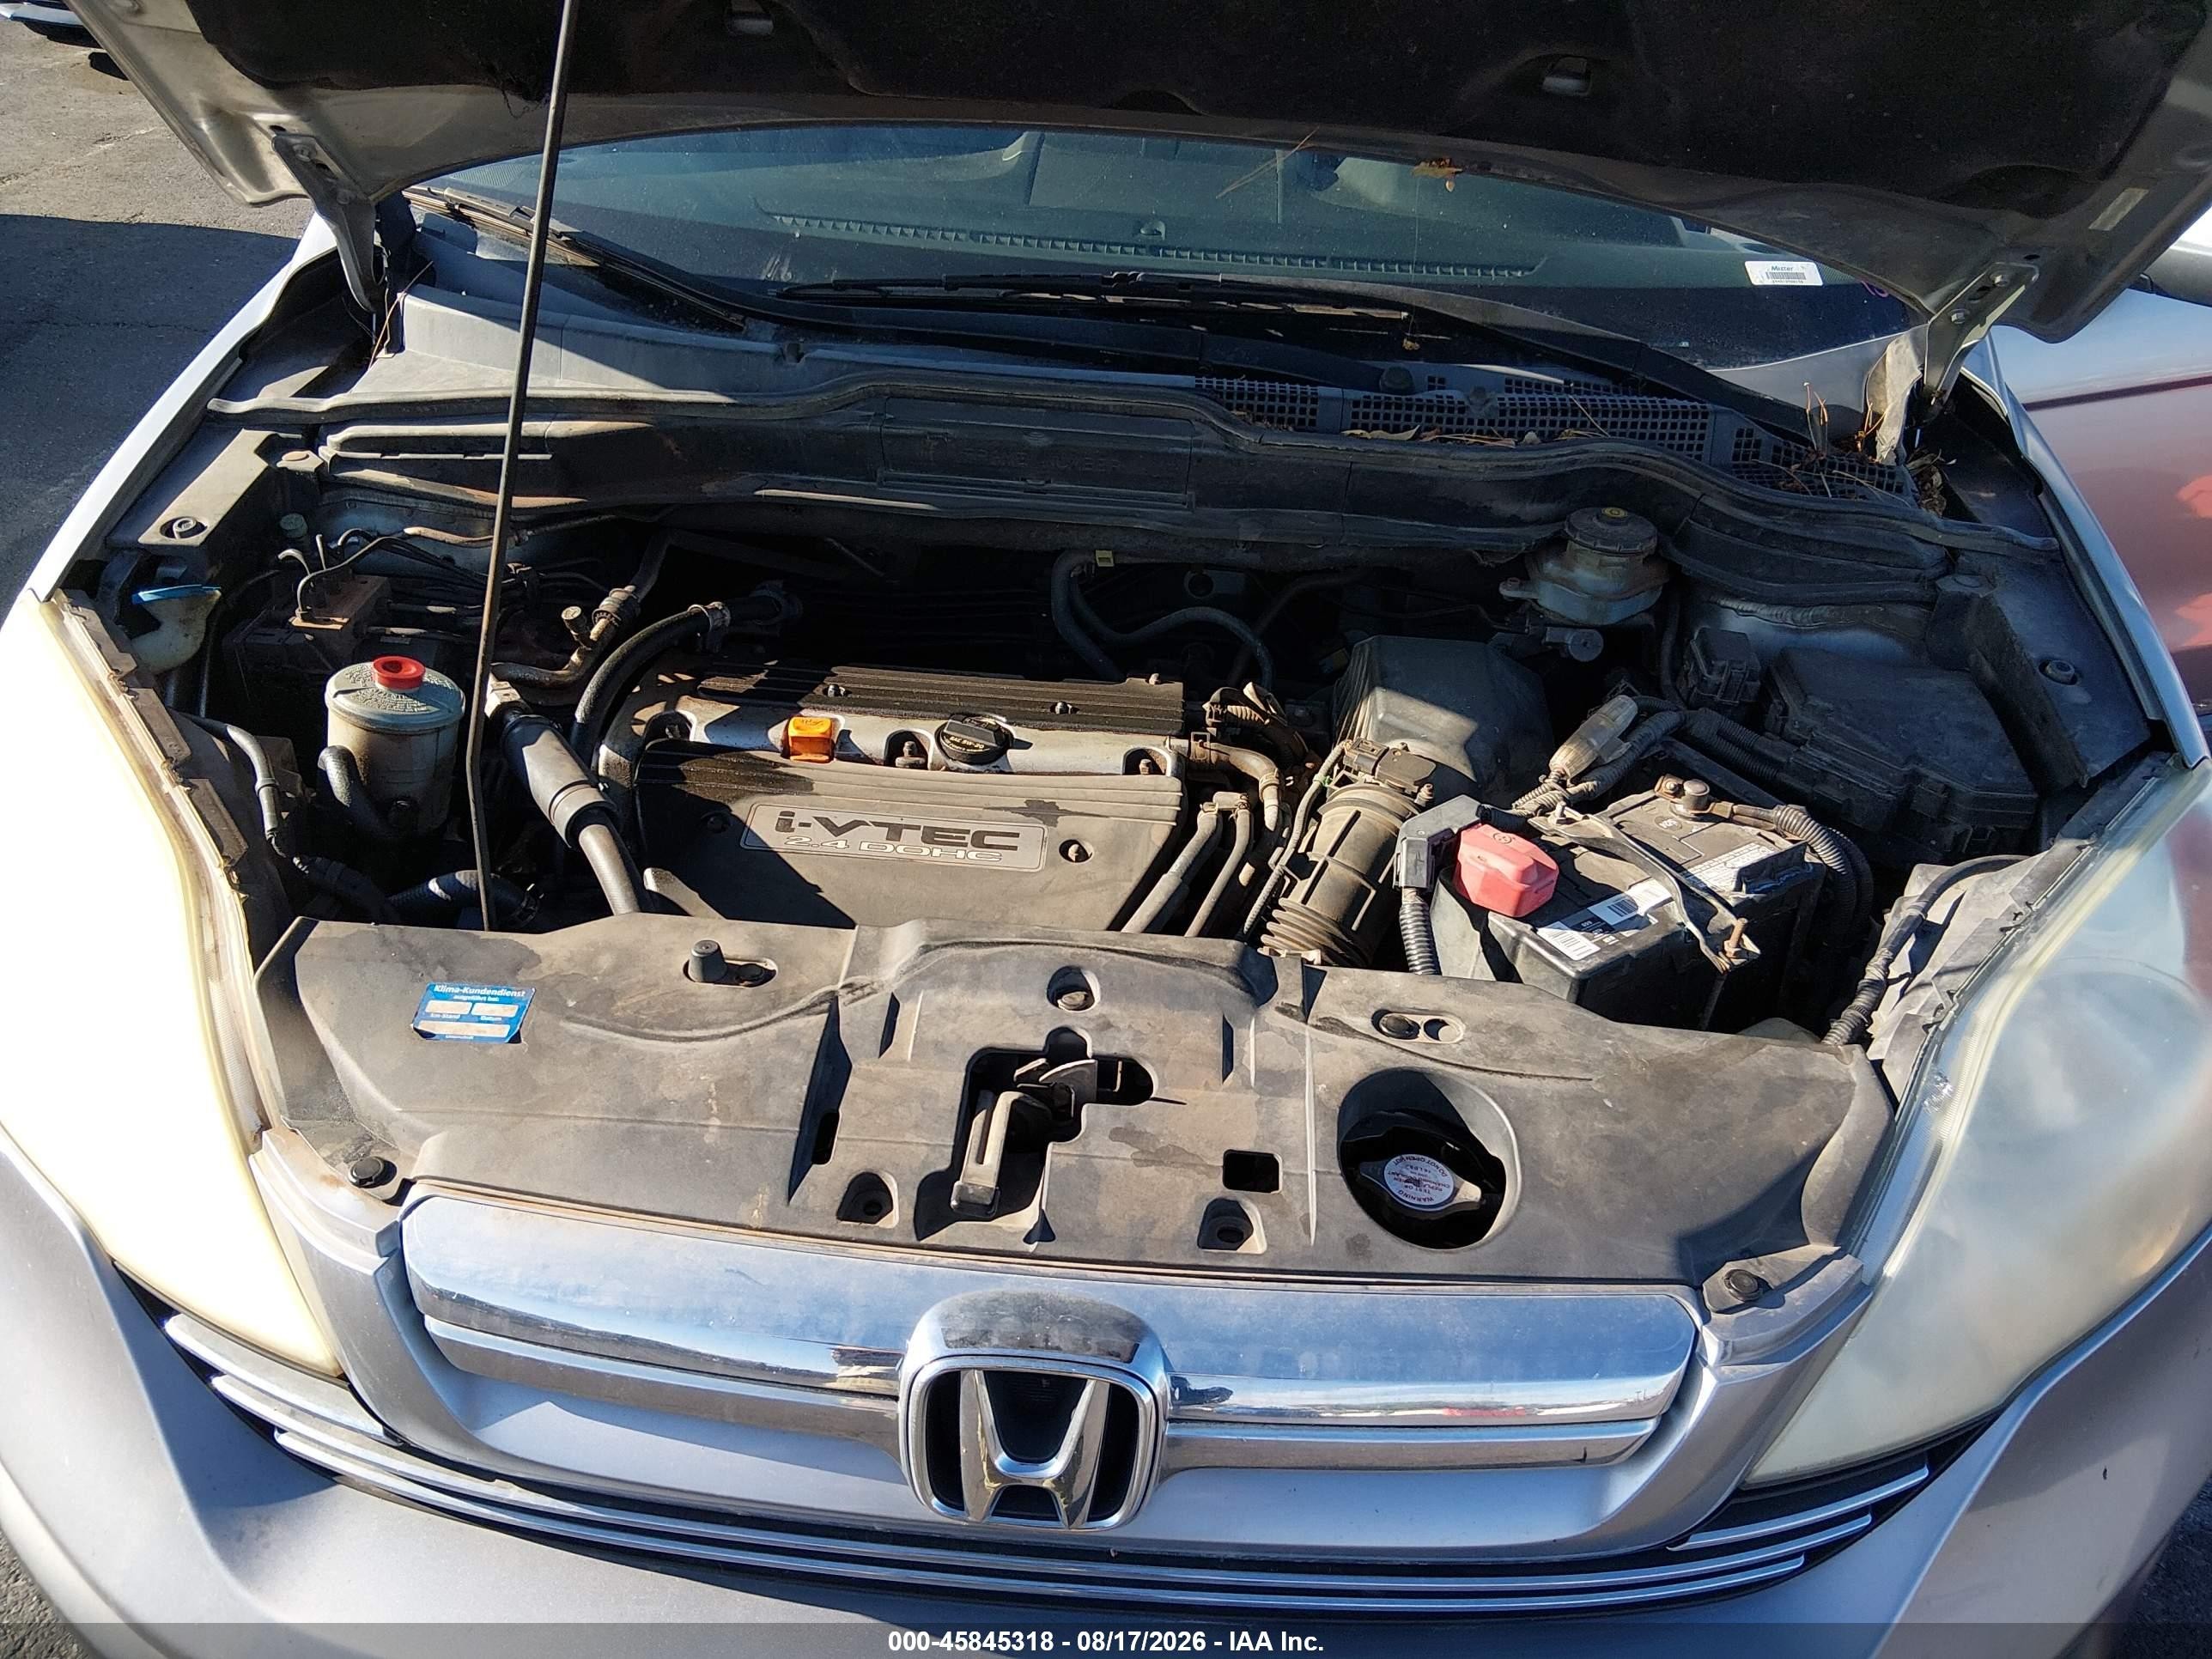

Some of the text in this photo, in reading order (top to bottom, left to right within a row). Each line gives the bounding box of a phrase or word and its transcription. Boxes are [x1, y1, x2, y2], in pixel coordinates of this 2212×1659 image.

[775, 810, 1020, 851] i-VTEC
[783, 836, 1003, 862] 2.4 DOHC
[434, 984, 526, 997] Klima-Kundendienst
[1427, 1159, 1439, 1170] NOT
[1398, 1189, 1434, 1202] WARNING
